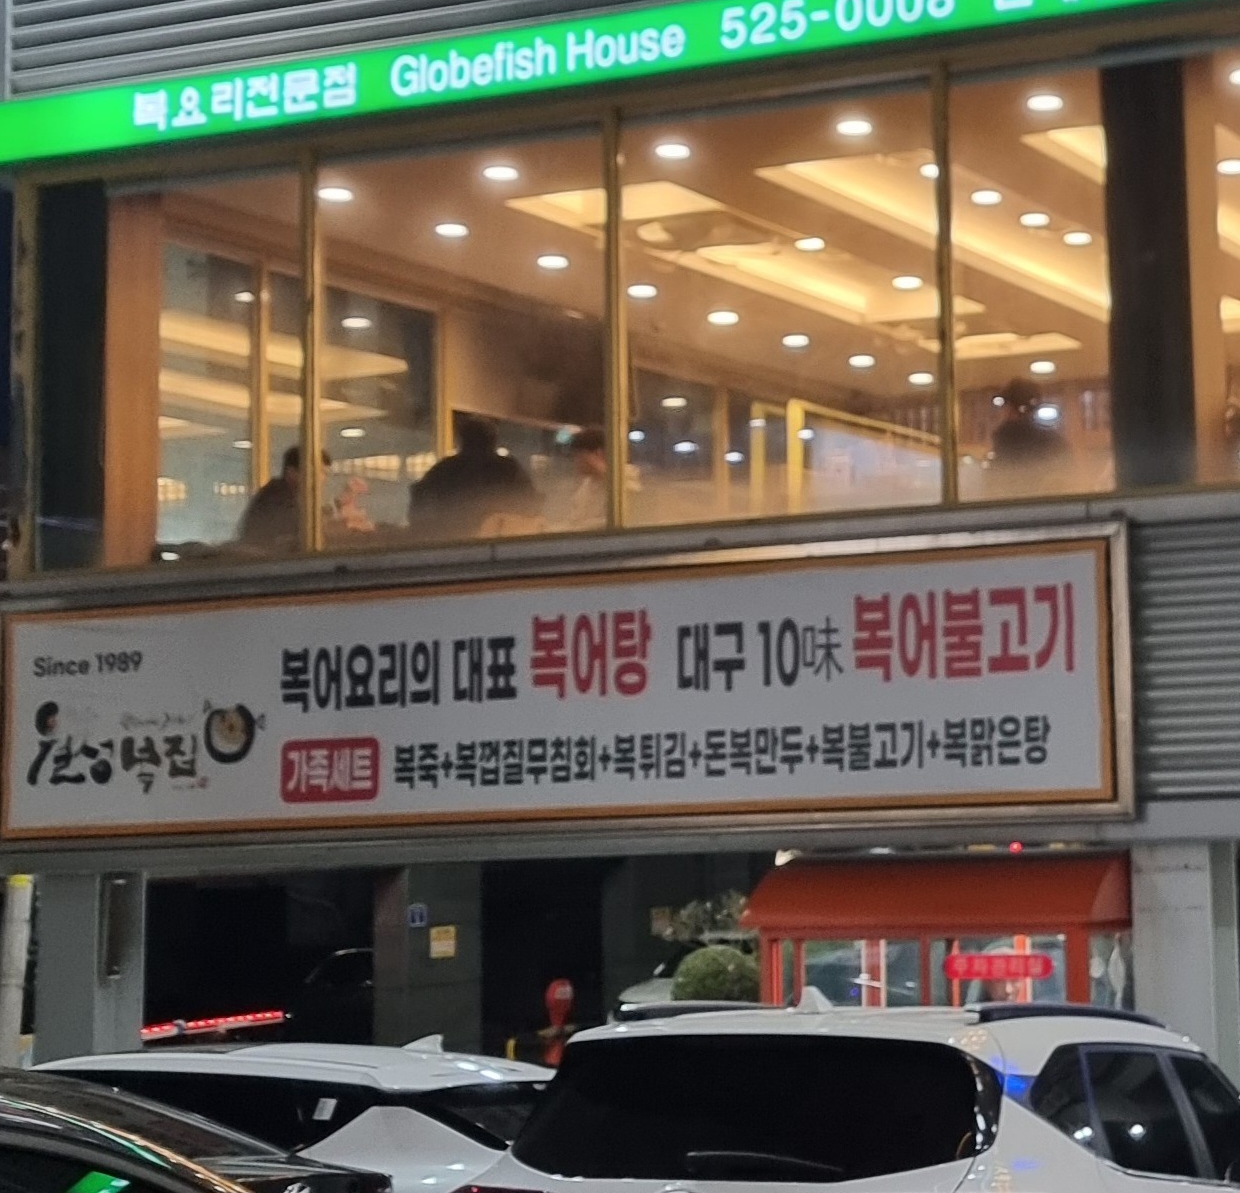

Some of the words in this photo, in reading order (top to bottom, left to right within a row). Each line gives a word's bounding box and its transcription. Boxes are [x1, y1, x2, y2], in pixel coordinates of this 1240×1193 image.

[133, 61, 358, 133] 복요리전문점
[389, 37, 557, 98] Globefish
[567, 24, 687, 73] House
[33, 657, 90, 677] Since
[95, 650, 142, 674] 1989
[280, 640, 441, 713] 복어요리의
[452, 636, 517, 704] 대표
[530, 608, 652, 700] 복어탕
[677, 618, 746, 692] 대구
[852, 583, 1075, 682] 복어불고기
[287, 746, 374, 794] 가족세트
